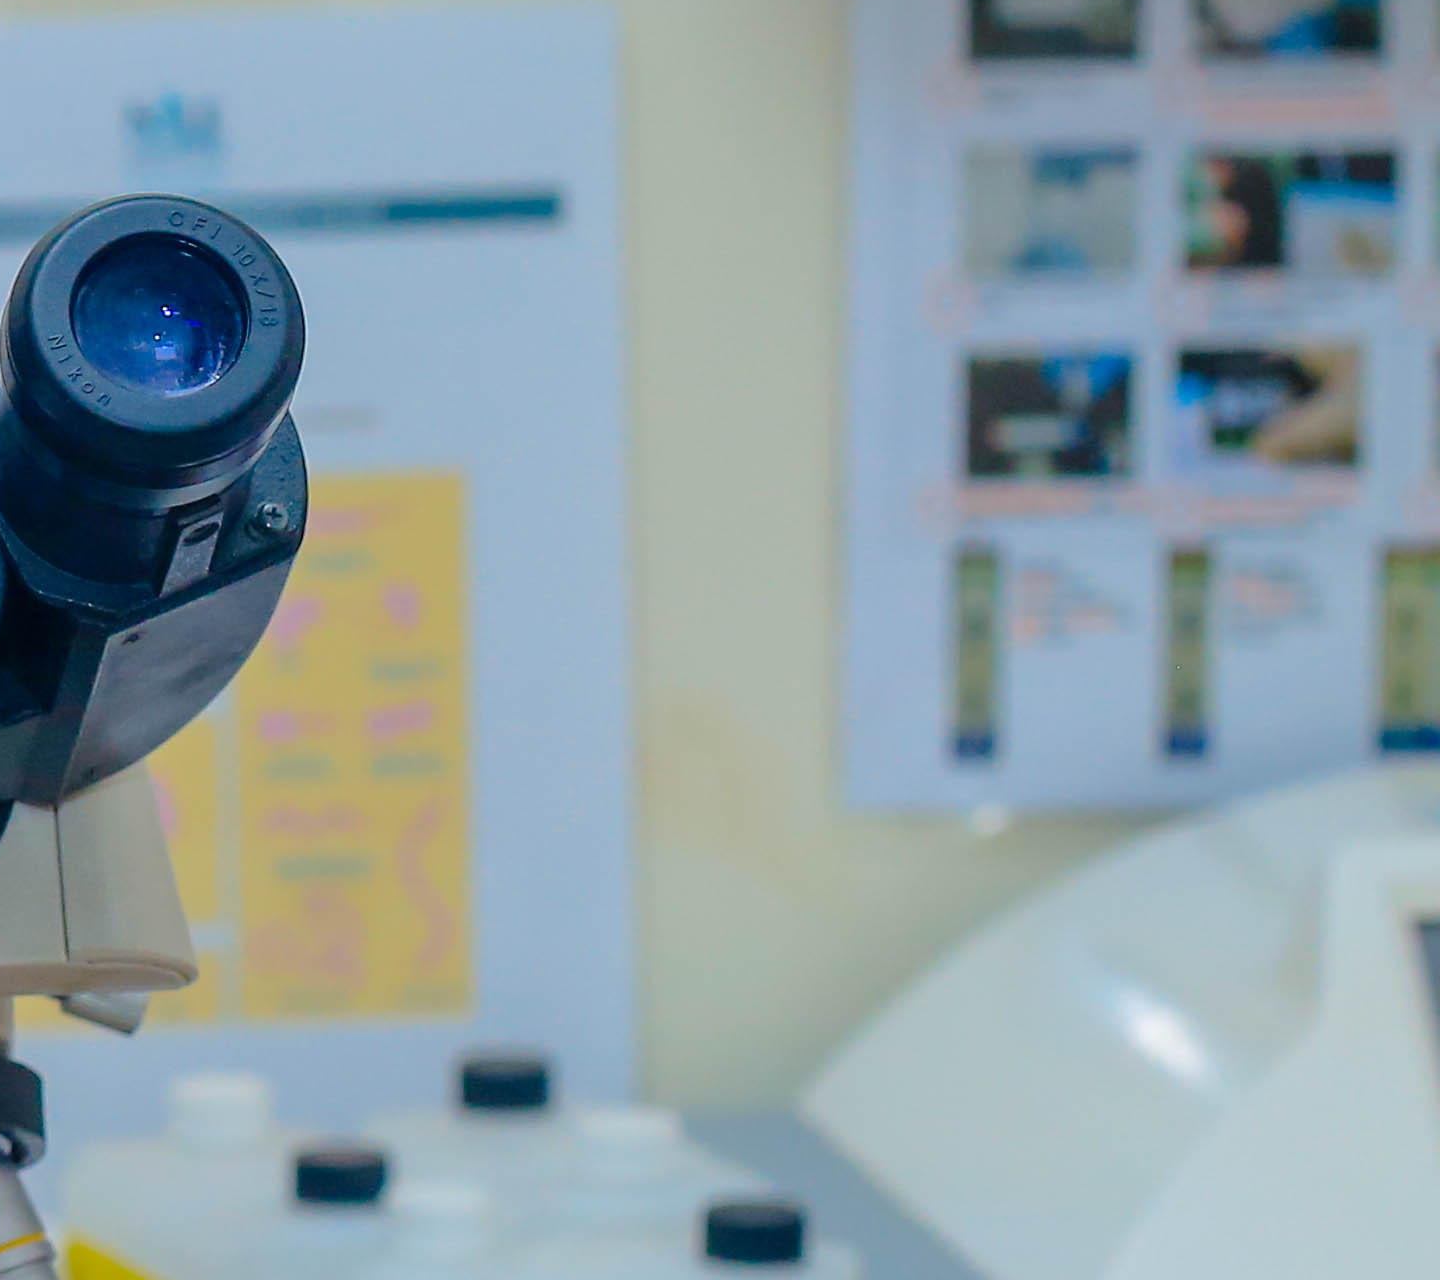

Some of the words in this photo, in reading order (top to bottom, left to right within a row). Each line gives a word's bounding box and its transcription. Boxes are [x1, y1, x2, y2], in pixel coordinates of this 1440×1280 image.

[167, 210, 223, 240] CFI
[232, 243, 281, 329] 10X/18
[46, 332, 113, 409] Nikon
